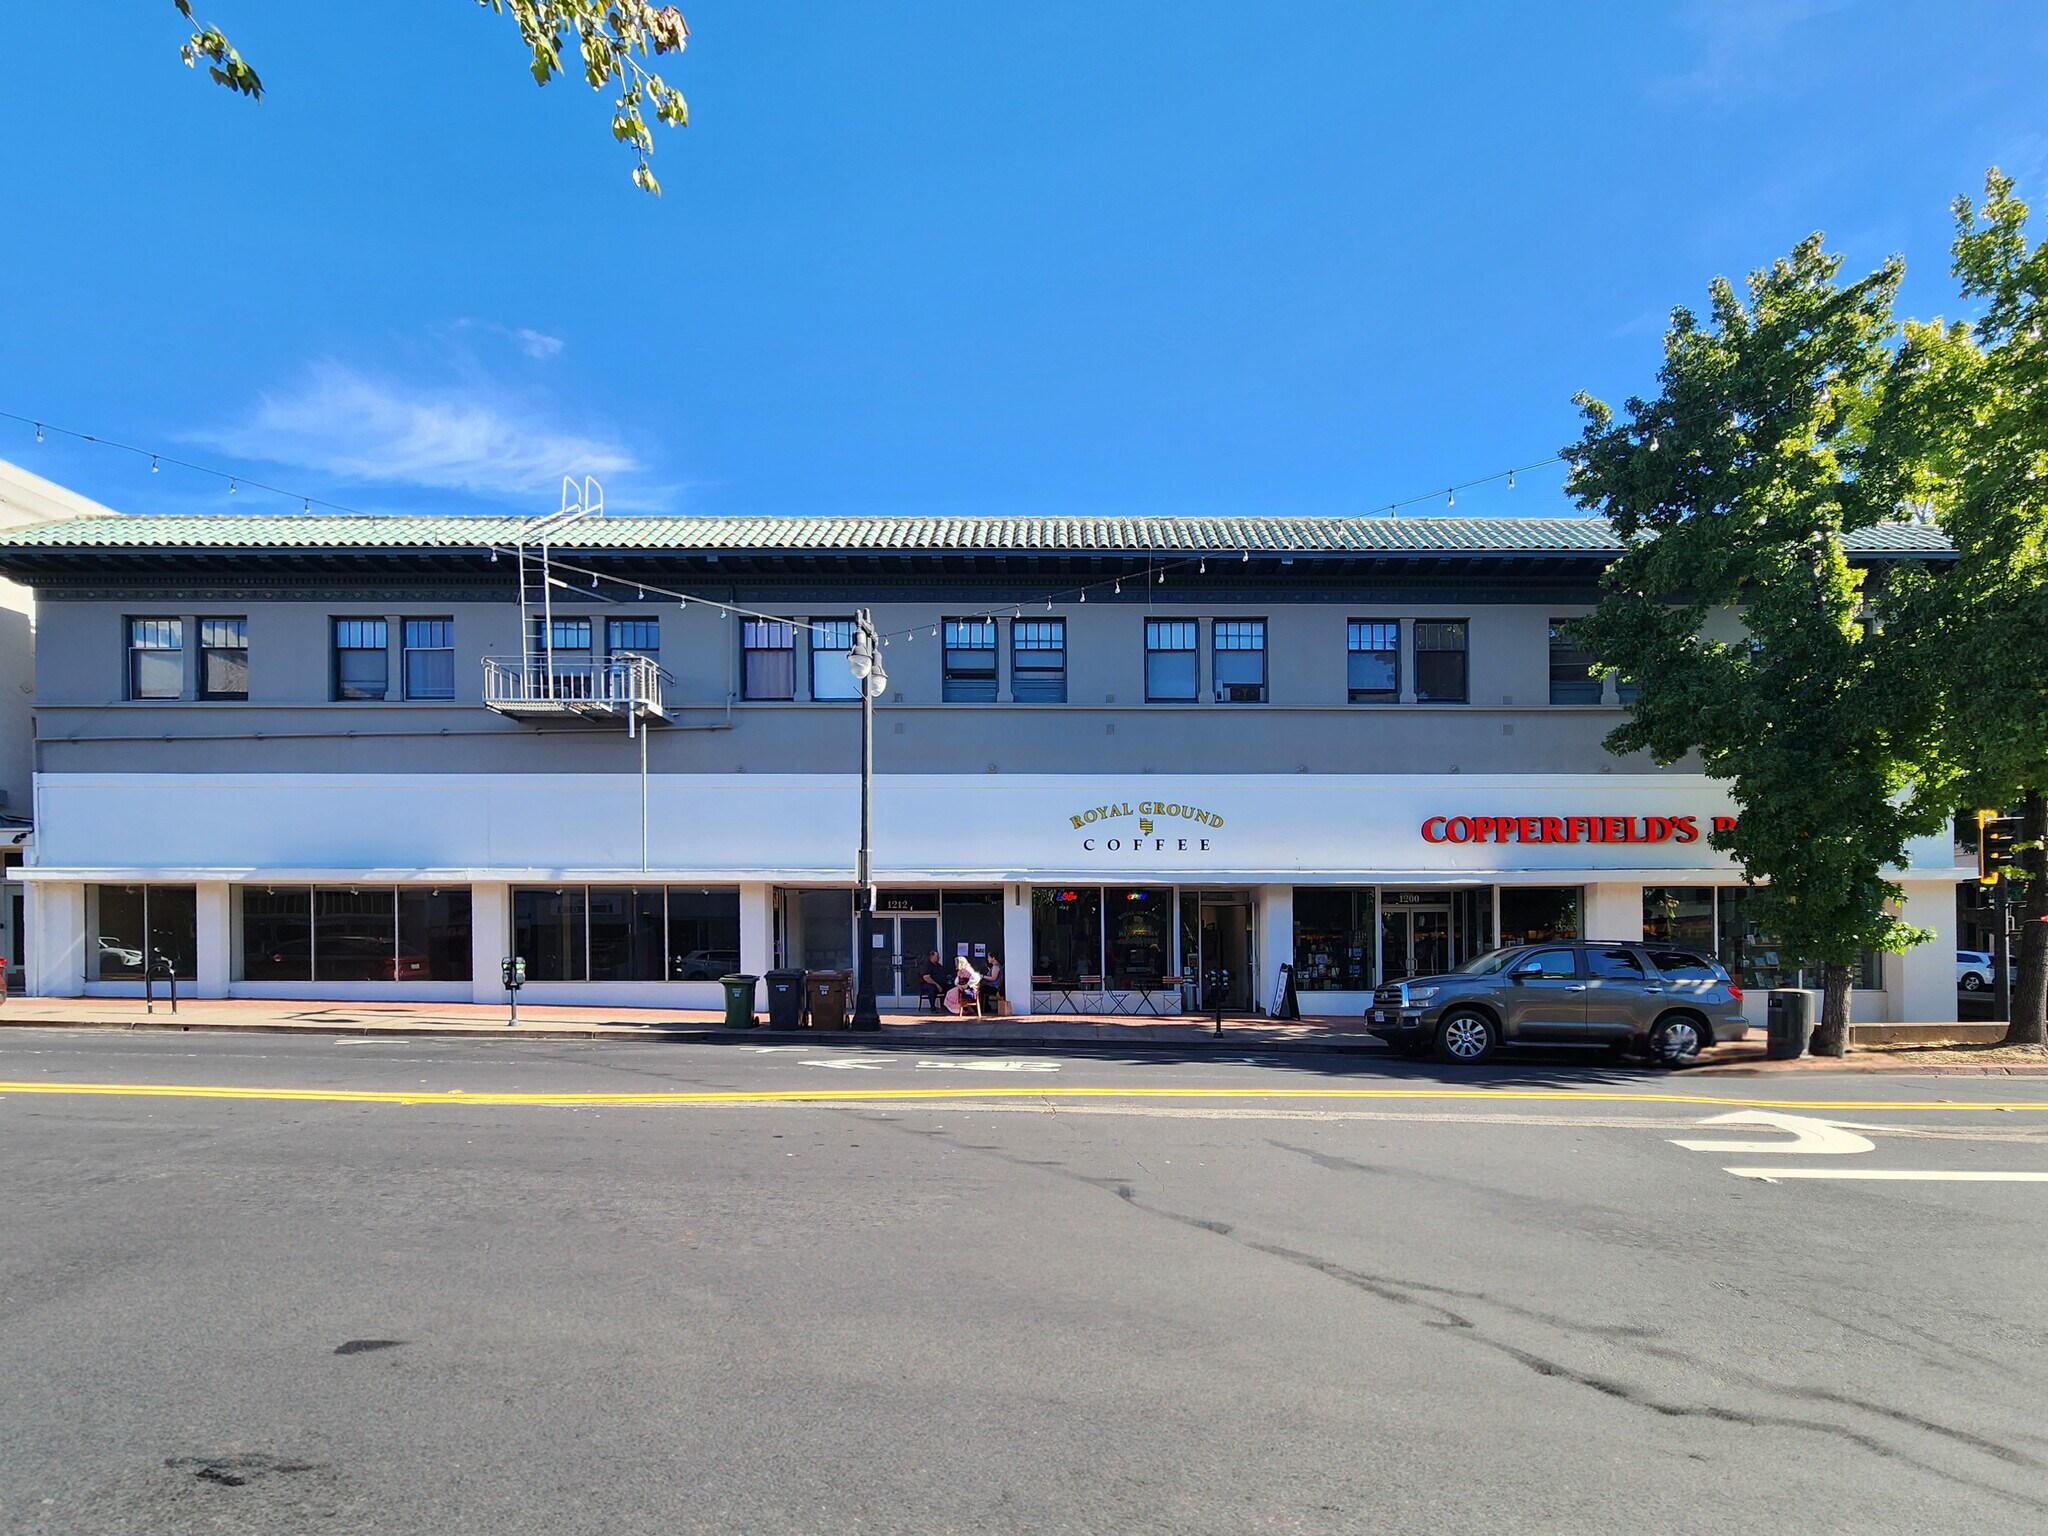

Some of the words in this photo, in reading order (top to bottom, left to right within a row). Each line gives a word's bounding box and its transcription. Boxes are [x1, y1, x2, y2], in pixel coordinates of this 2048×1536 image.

[1069, 802, 1134, 830] ROYAL
[1138, 801, 1225, 829] GROUND
[1421, 816, 1699, 843] COPPERFIELD'S
[1083, 838, 1210, 851] COFFEE
[887, 900, 908, 909] 1212
[1400, 894, 1420, 903] 1200
